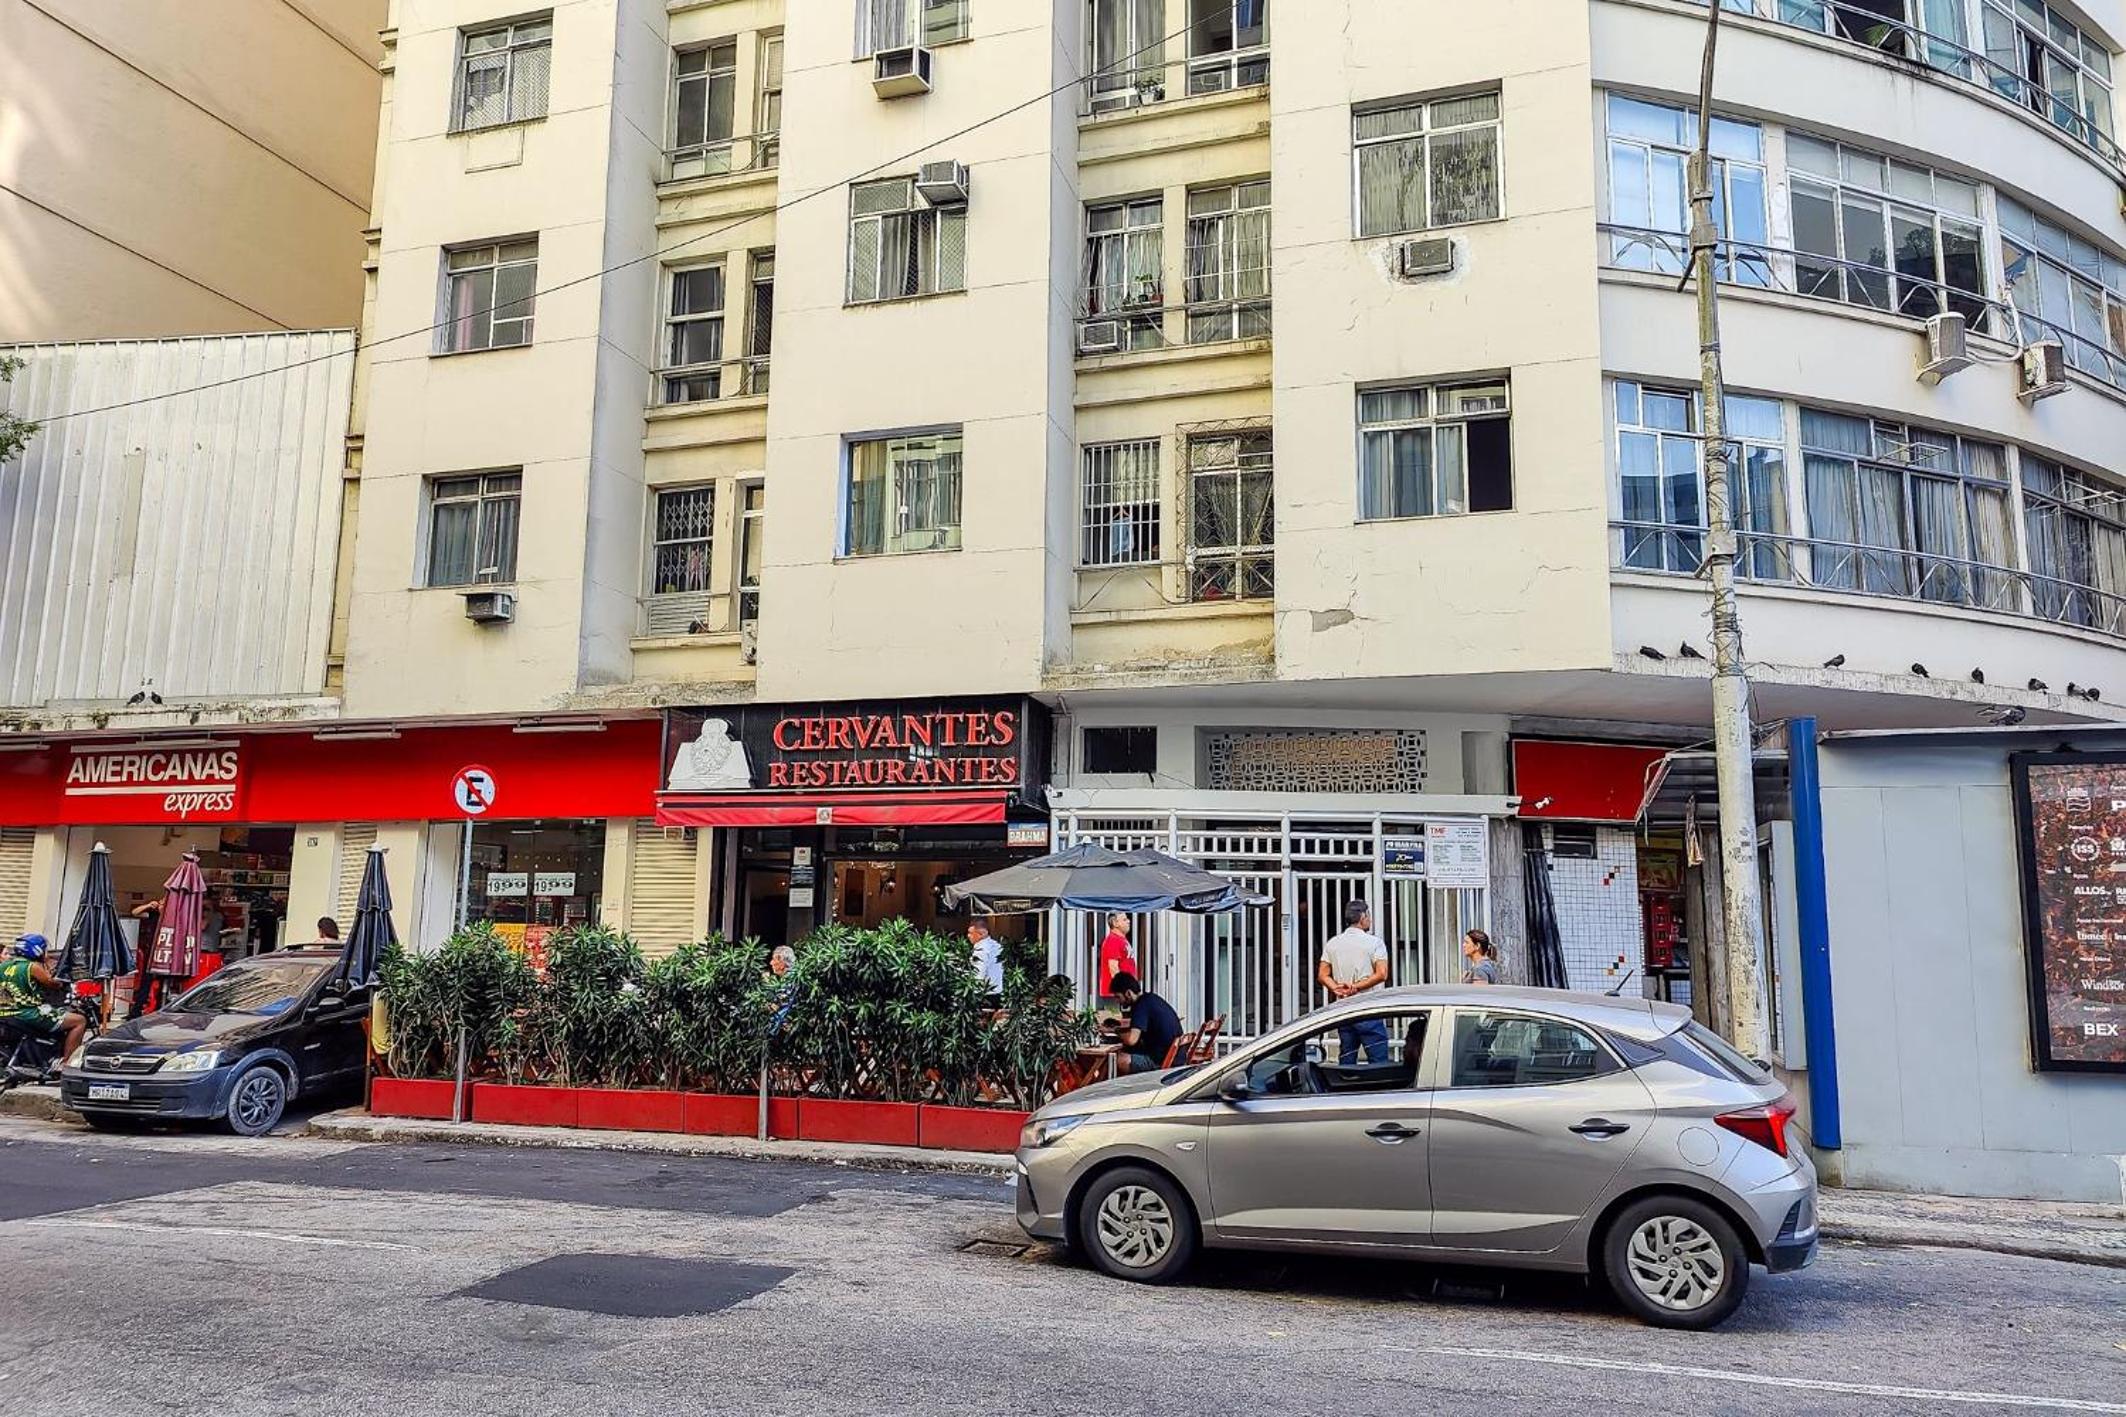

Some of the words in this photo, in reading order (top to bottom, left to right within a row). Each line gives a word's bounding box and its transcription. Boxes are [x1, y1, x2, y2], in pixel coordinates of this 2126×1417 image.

[773, 711, 1015, 751] CERVANTES
[66, 751, 238, 784] AMERICANAS
[768, 756, 1017, 787] RESTAURANTES
[466, 776, 484, 806] E
[163, 792, 235, 820] express
[1008, 831, 1046, 845] BRAHMA
[2073, 886, 2106, 896] ALLOS
[2083, 1022, 2119, 1037] BEX
